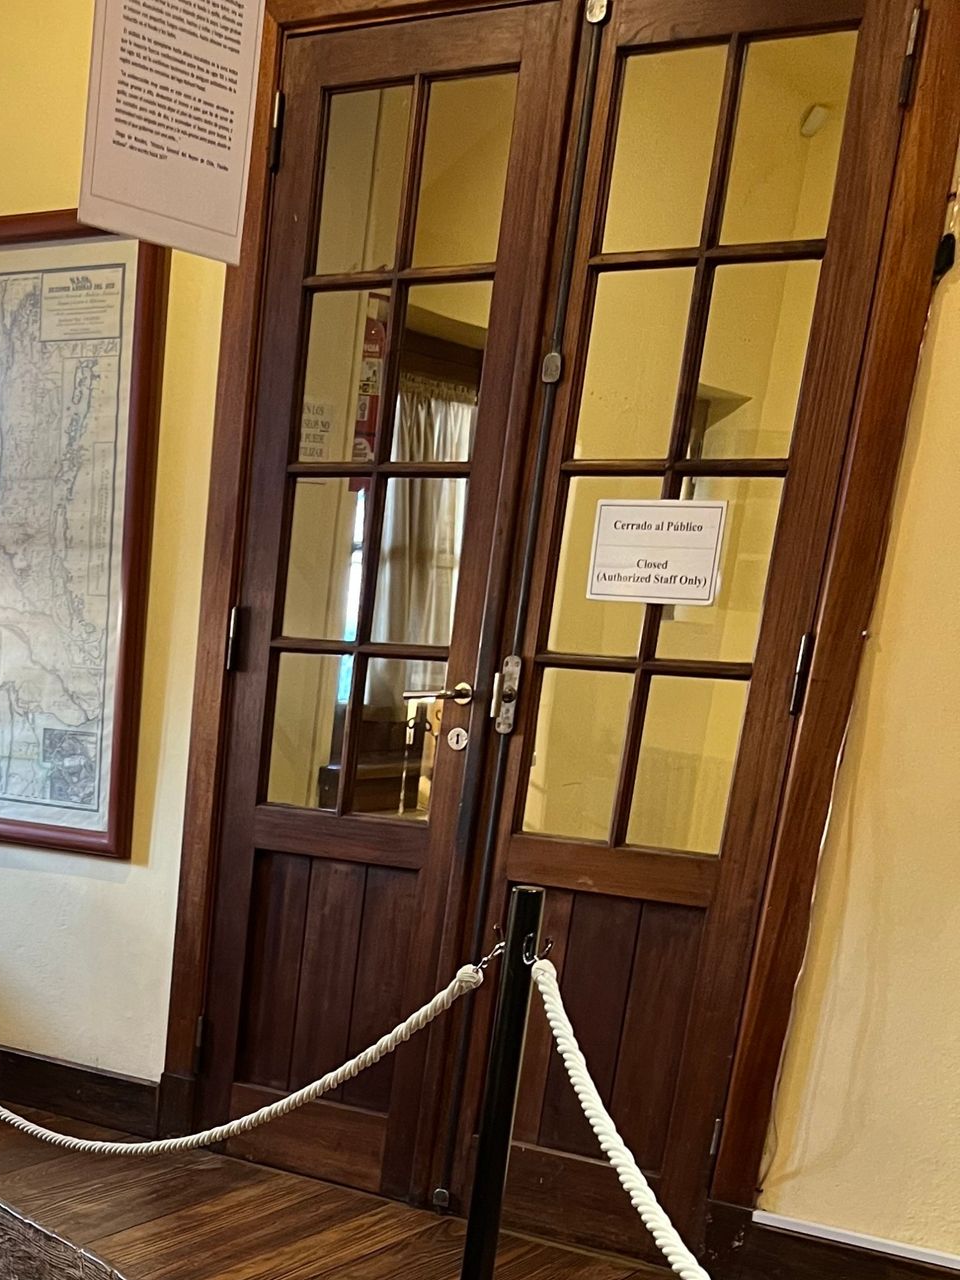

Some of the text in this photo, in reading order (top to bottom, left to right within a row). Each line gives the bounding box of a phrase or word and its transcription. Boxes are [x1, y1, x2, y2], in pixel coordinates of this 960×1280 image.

[613, 519, 703, 532] Cerrado al Público
[636, 559, 668, 570] Closed
[596, 571, 707, 588] (Authorized Staff Only)
